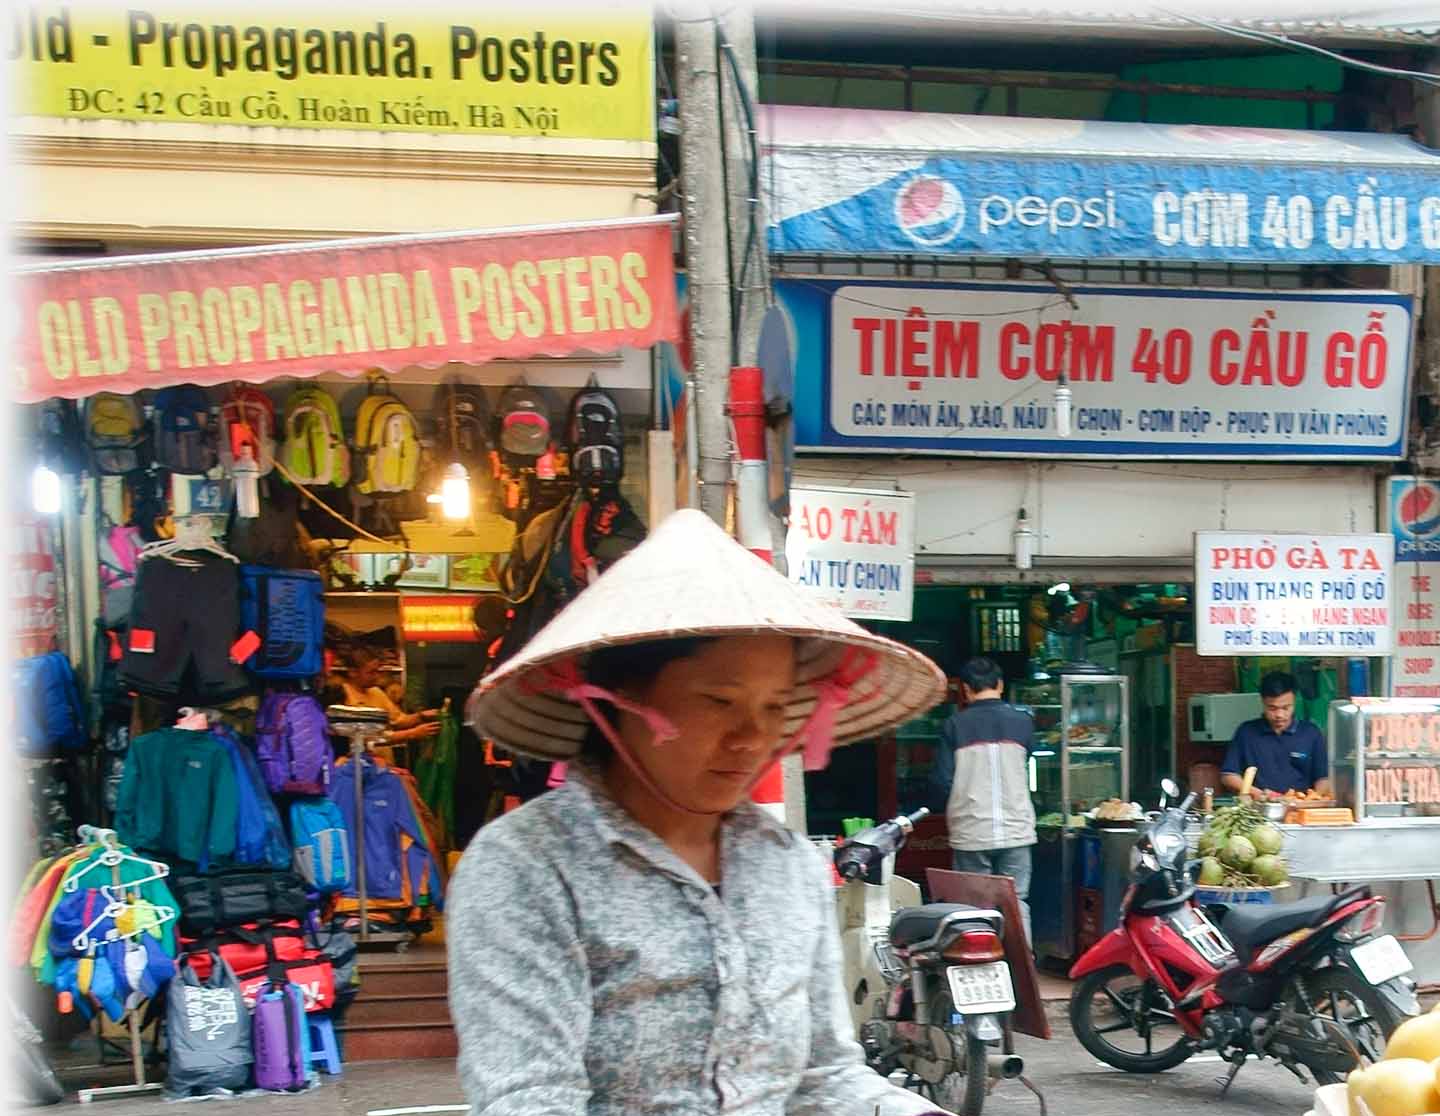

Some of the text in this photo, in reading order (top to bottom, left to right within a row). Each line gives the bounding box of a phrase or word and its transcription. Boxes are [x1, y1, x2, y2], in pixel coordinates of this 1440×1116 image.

[127, 8, 433, 83] Propaganda.
[450, 24, 621, 88] Posters
[68, 87, 124, 114] ĐC:
[135, 91, 165, 115] 42
[176, 86, 232, 118] Cầu
[299, 98, 370, 124] Hoàn
[467, 104, 505, 129] Hà
[513, 103, 560, 135] Nội
[979, 190, 1117, 236] pepsi
[1262, 196, 1314, 250] 40
[1325, 177, 1408, 251] CẦU
[38, 251, 655, 381] OLD PROPAGANDA POSTERS
[852, 305, 1389, 392] TIỆM CƠM 40 CẦU GỖ
[852, 400, 887, 427] CÁC
[890, 400, 930, 428] MÓN
[1077, 407, 1123, 437] CHỌN
[1180, 405, 1211, 438] HỘP
[1226, 410, 1269, 439] PHỤC
[1274, 411, 1295, 439] VỤ
[1299, 407, 1331, 436] VĂN
[1334, 407, 1388, 437] PHÒNG
[841, 499, 899, 546] TÁM
[827, 559, 852, 594] TỰ
[854, 562, 902, 597] CHỌN
[1211, 539, 1383, 571] PHỞ GÀ TA
[1211, 576, 1250, 601] BÚN
[1254, 580, 1314, 601] THANG
[1365, 760, 1403, 805] BÚN
